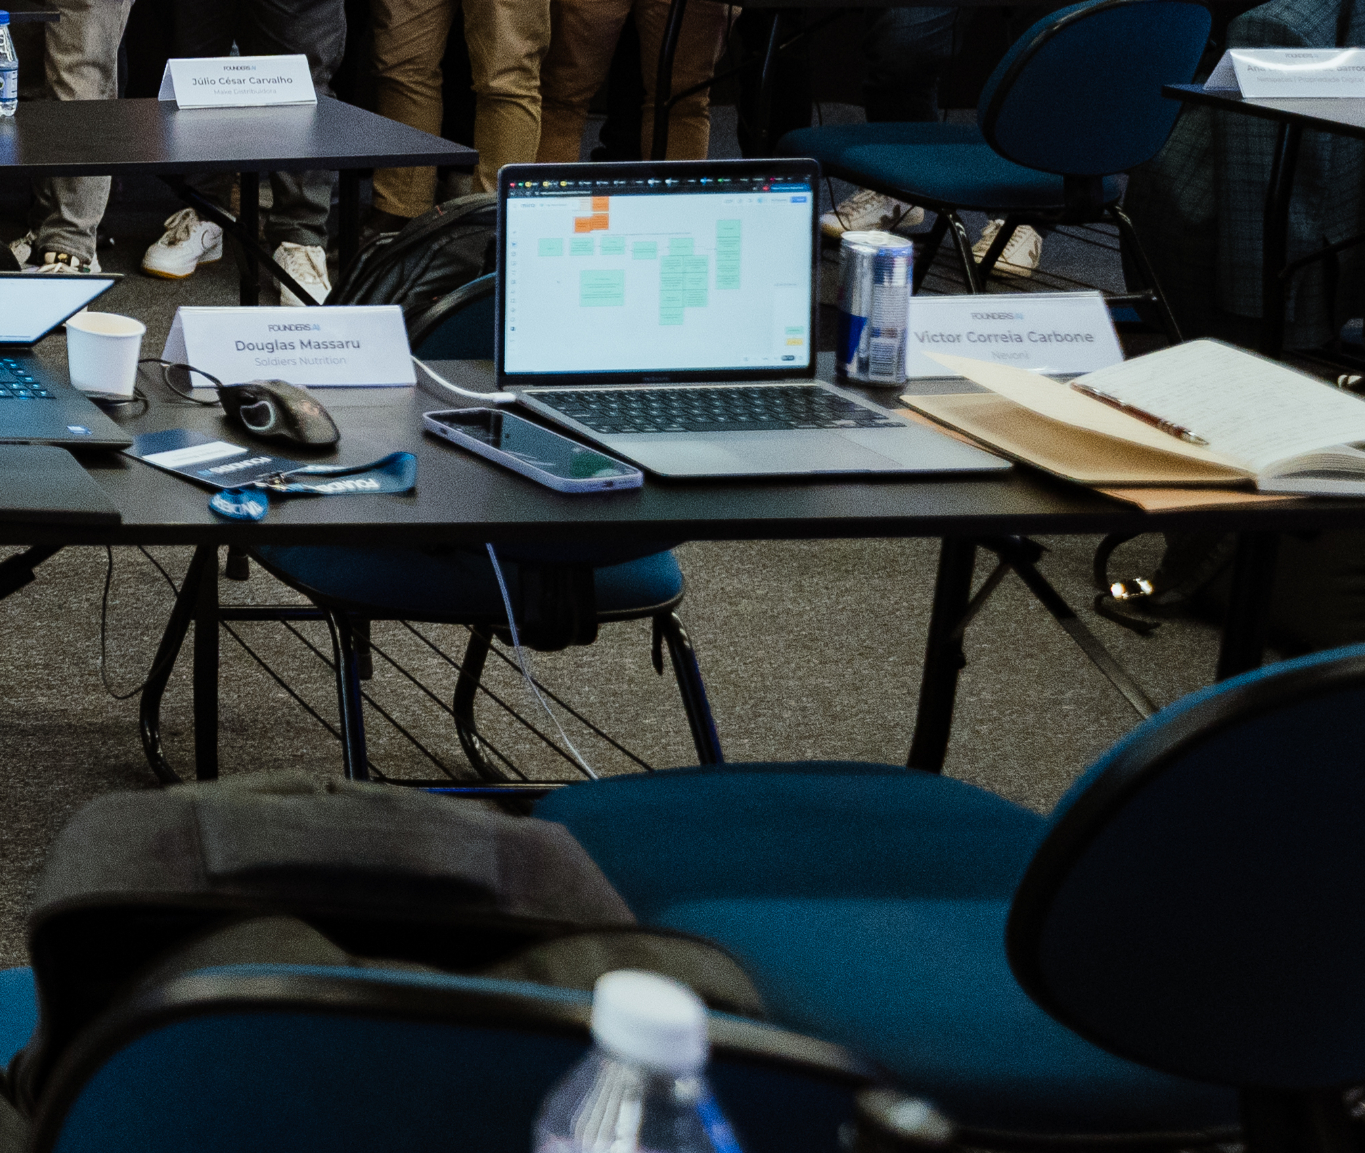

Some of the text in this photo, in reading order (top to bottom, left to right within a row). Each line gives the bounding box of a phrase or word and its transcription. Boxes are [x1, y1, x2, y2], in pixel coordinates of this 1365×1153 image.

[192, 75, 293, 86] Júlio César Carvalho
[972, 312, 1014, 320] FOUNDERS
[268, 324, 311, 332] FOUNDERS
[914, 330, 1094, 343] Victor Correia Carbone
[235, 339, 361, 353] Douglas Massaru
[255, 356, 347, 366] Soldiers Nutrition
[209, 456, 272, 474] FOUNDERS
